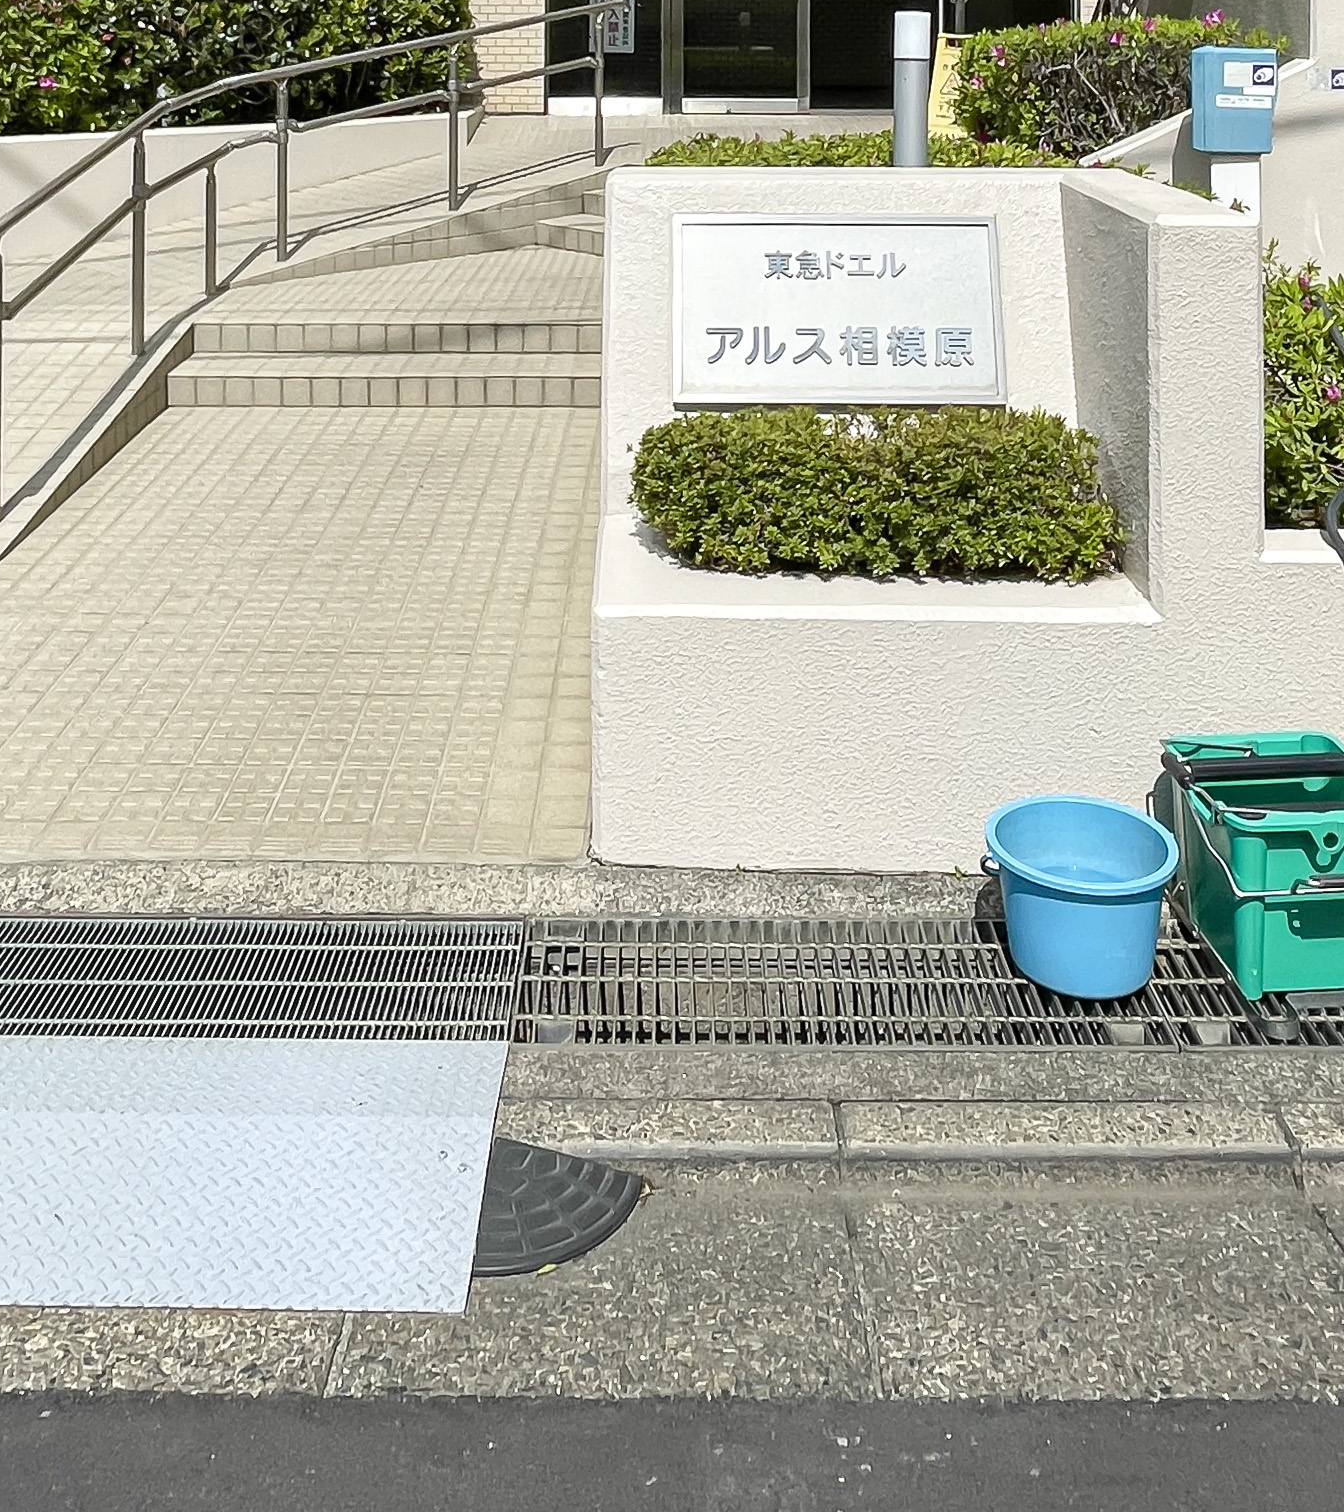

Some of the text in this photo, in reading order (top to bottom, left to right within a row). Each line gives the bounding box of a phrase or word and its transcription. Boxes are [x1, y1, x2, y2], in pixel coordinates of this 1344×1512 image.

[763, 249, 907, 280] 東急ドエル
[705, 324, 975, 367] アルス相模原
